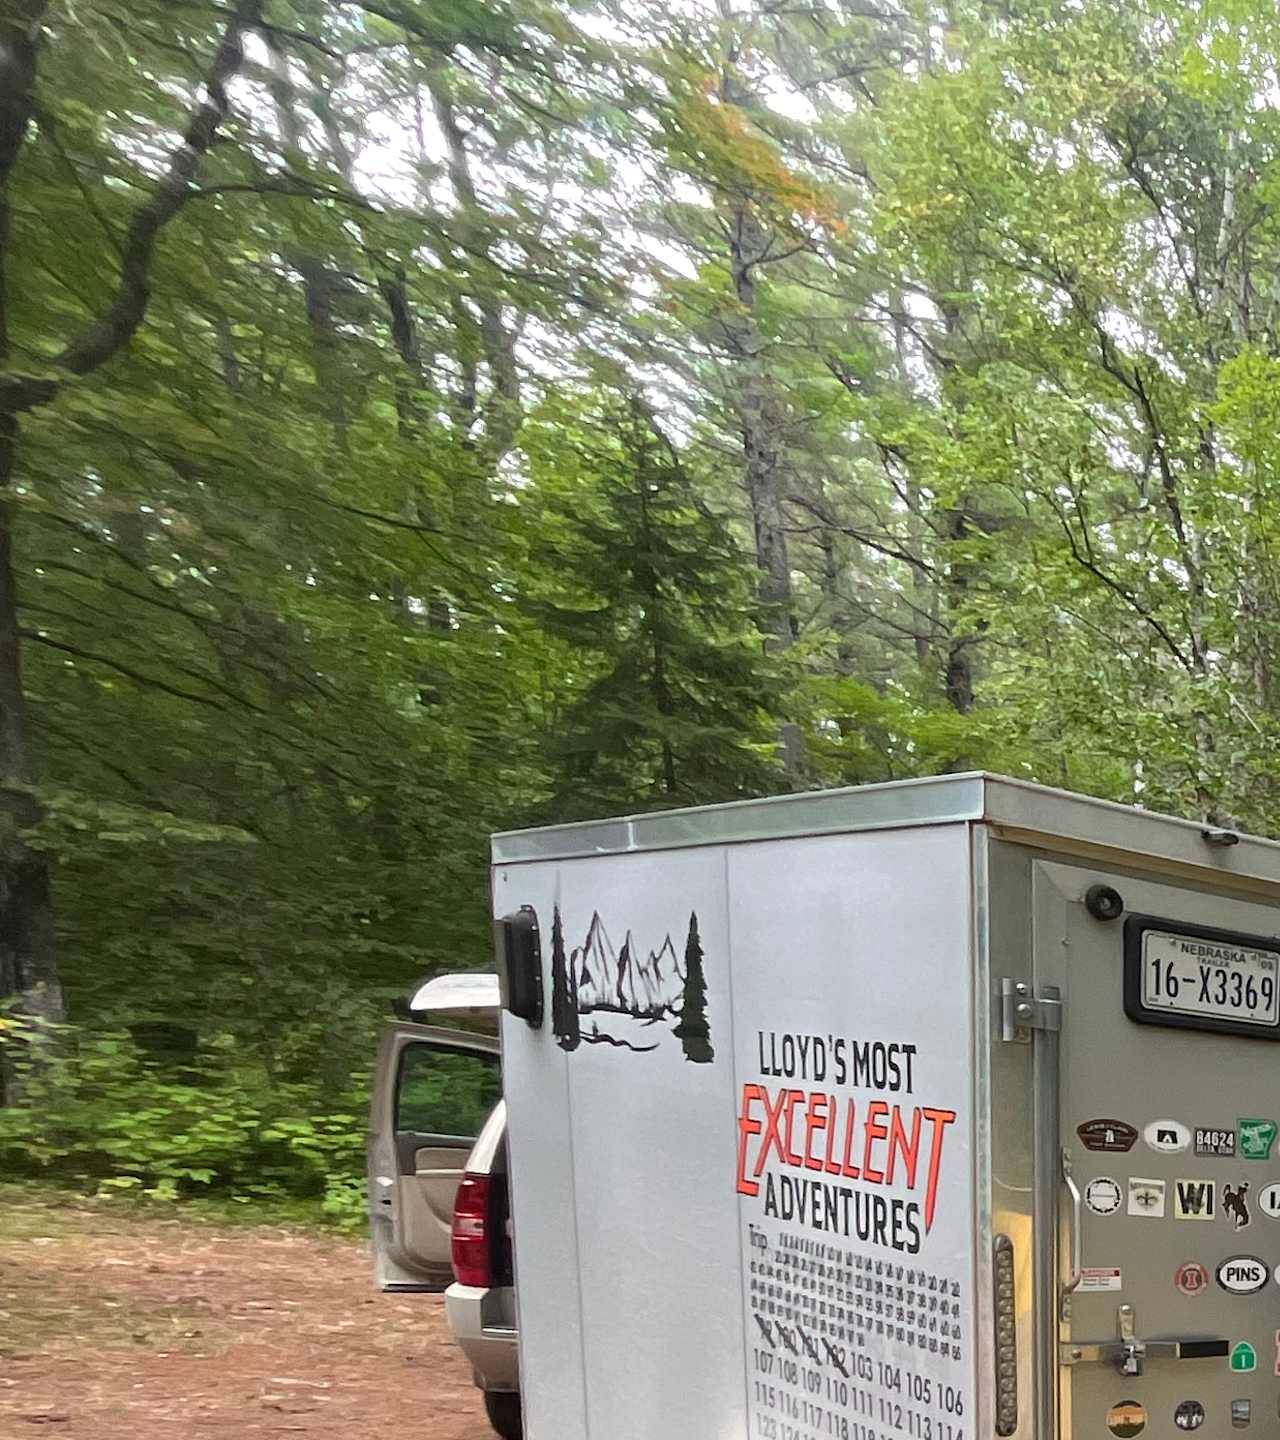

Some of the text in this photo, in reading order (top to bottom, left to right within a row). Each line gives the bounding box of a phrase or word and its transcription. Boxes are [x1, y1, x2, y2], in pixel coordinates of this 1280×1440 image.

[1181, 943, 1246, 963] NEBRASKA
[1152, 959, 1273, 1011] 16-X3369
[759, 1031, 917, 1094] LLOYD'S MOST
[736, 1083, 956, 1236] EXCELLENT
[764, 1173, 921, 1255] ADVENTURES
[1177, 1183, 1213, 1214] WI
[1226, 1267, 1259, 1282] PINS
[754, 1348, 774, 1375] 107
[778, 1357, 798, 1386] 108
[802, 1367, 822, 1396] 109
[826, 1377, 848, 1406] 110
[852, 1387, 873, 1417] 111
[879, 1398, 902, 1430] 112
[755, 1381, 776, 1408] 115
[779, 1390, 799, 1420] 116
[802, 1401, 824, 1430] 117
[851, 1352, 873, 1382] 103
[879, 1362, 901, 1392] 104
[907, 1372, 931, 1405] 105
[937, 1383, 963, 1416] 106
[756, 1412, 777, 1440] 123
